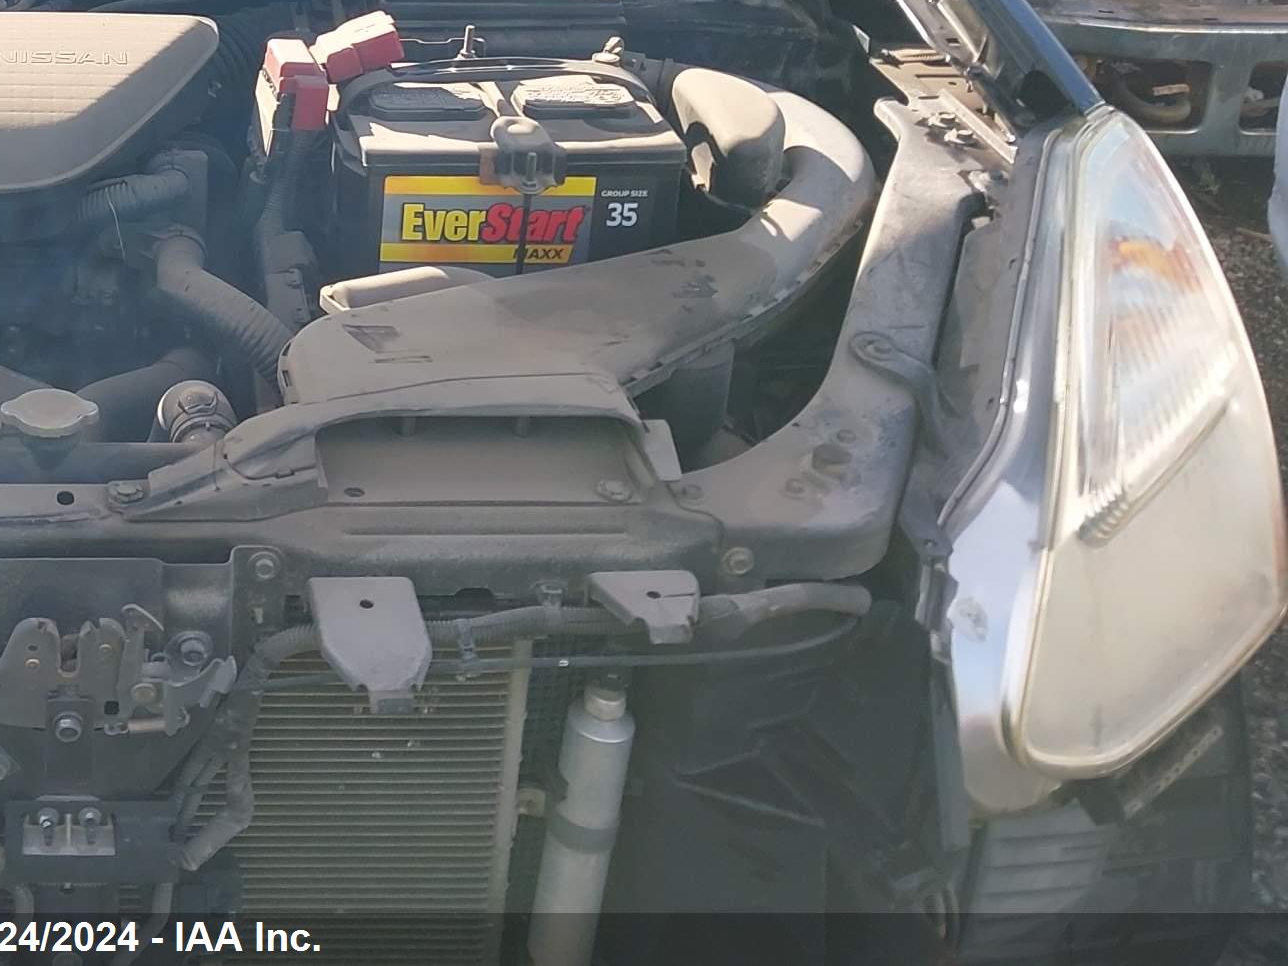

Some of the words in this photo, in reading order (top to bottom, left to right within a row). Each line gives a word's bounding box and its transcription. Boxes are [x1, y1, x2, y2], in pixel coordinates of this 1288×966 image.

[600, 189, 630, 198] GROUP
[630, 189, 649, 198] SIZE
[401, 202, 585, 244] EverStart
[606, 202, 639, 227] 35
